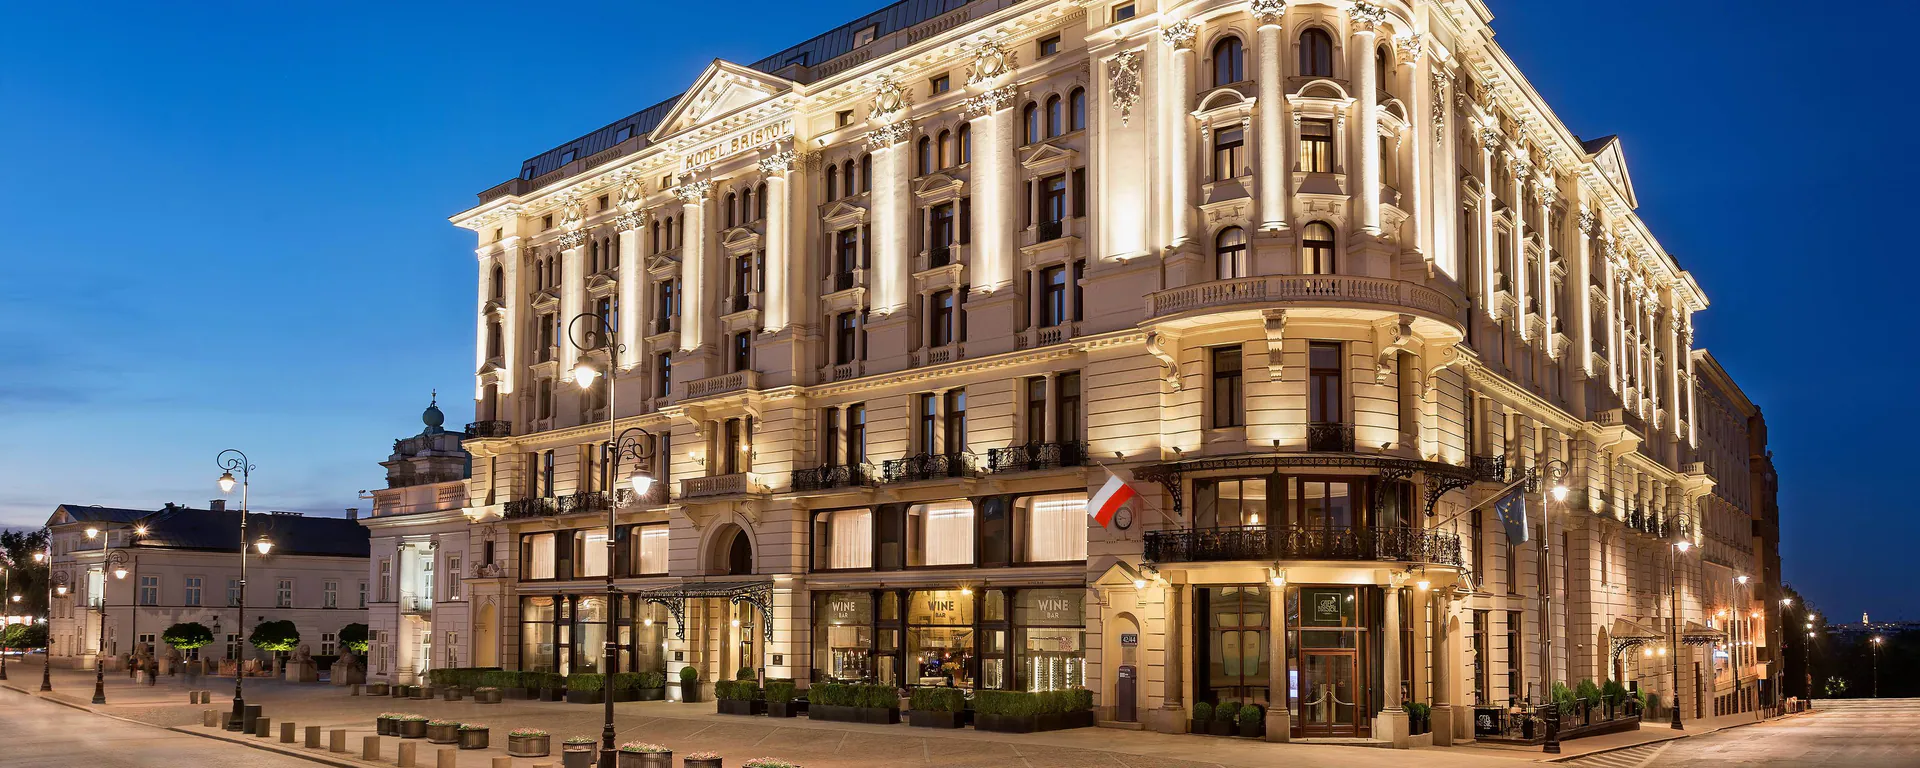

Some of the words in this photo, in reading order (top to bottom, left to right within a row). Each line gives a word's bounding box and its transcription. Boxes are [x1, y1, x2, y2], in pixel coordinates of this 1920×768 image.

[685, 144, 726, 169] HOTEL
[832, 601, 856, 611] WINE
[928, 601, 954, 611] WINE
[1038, 600, 1069, 610] WINE
